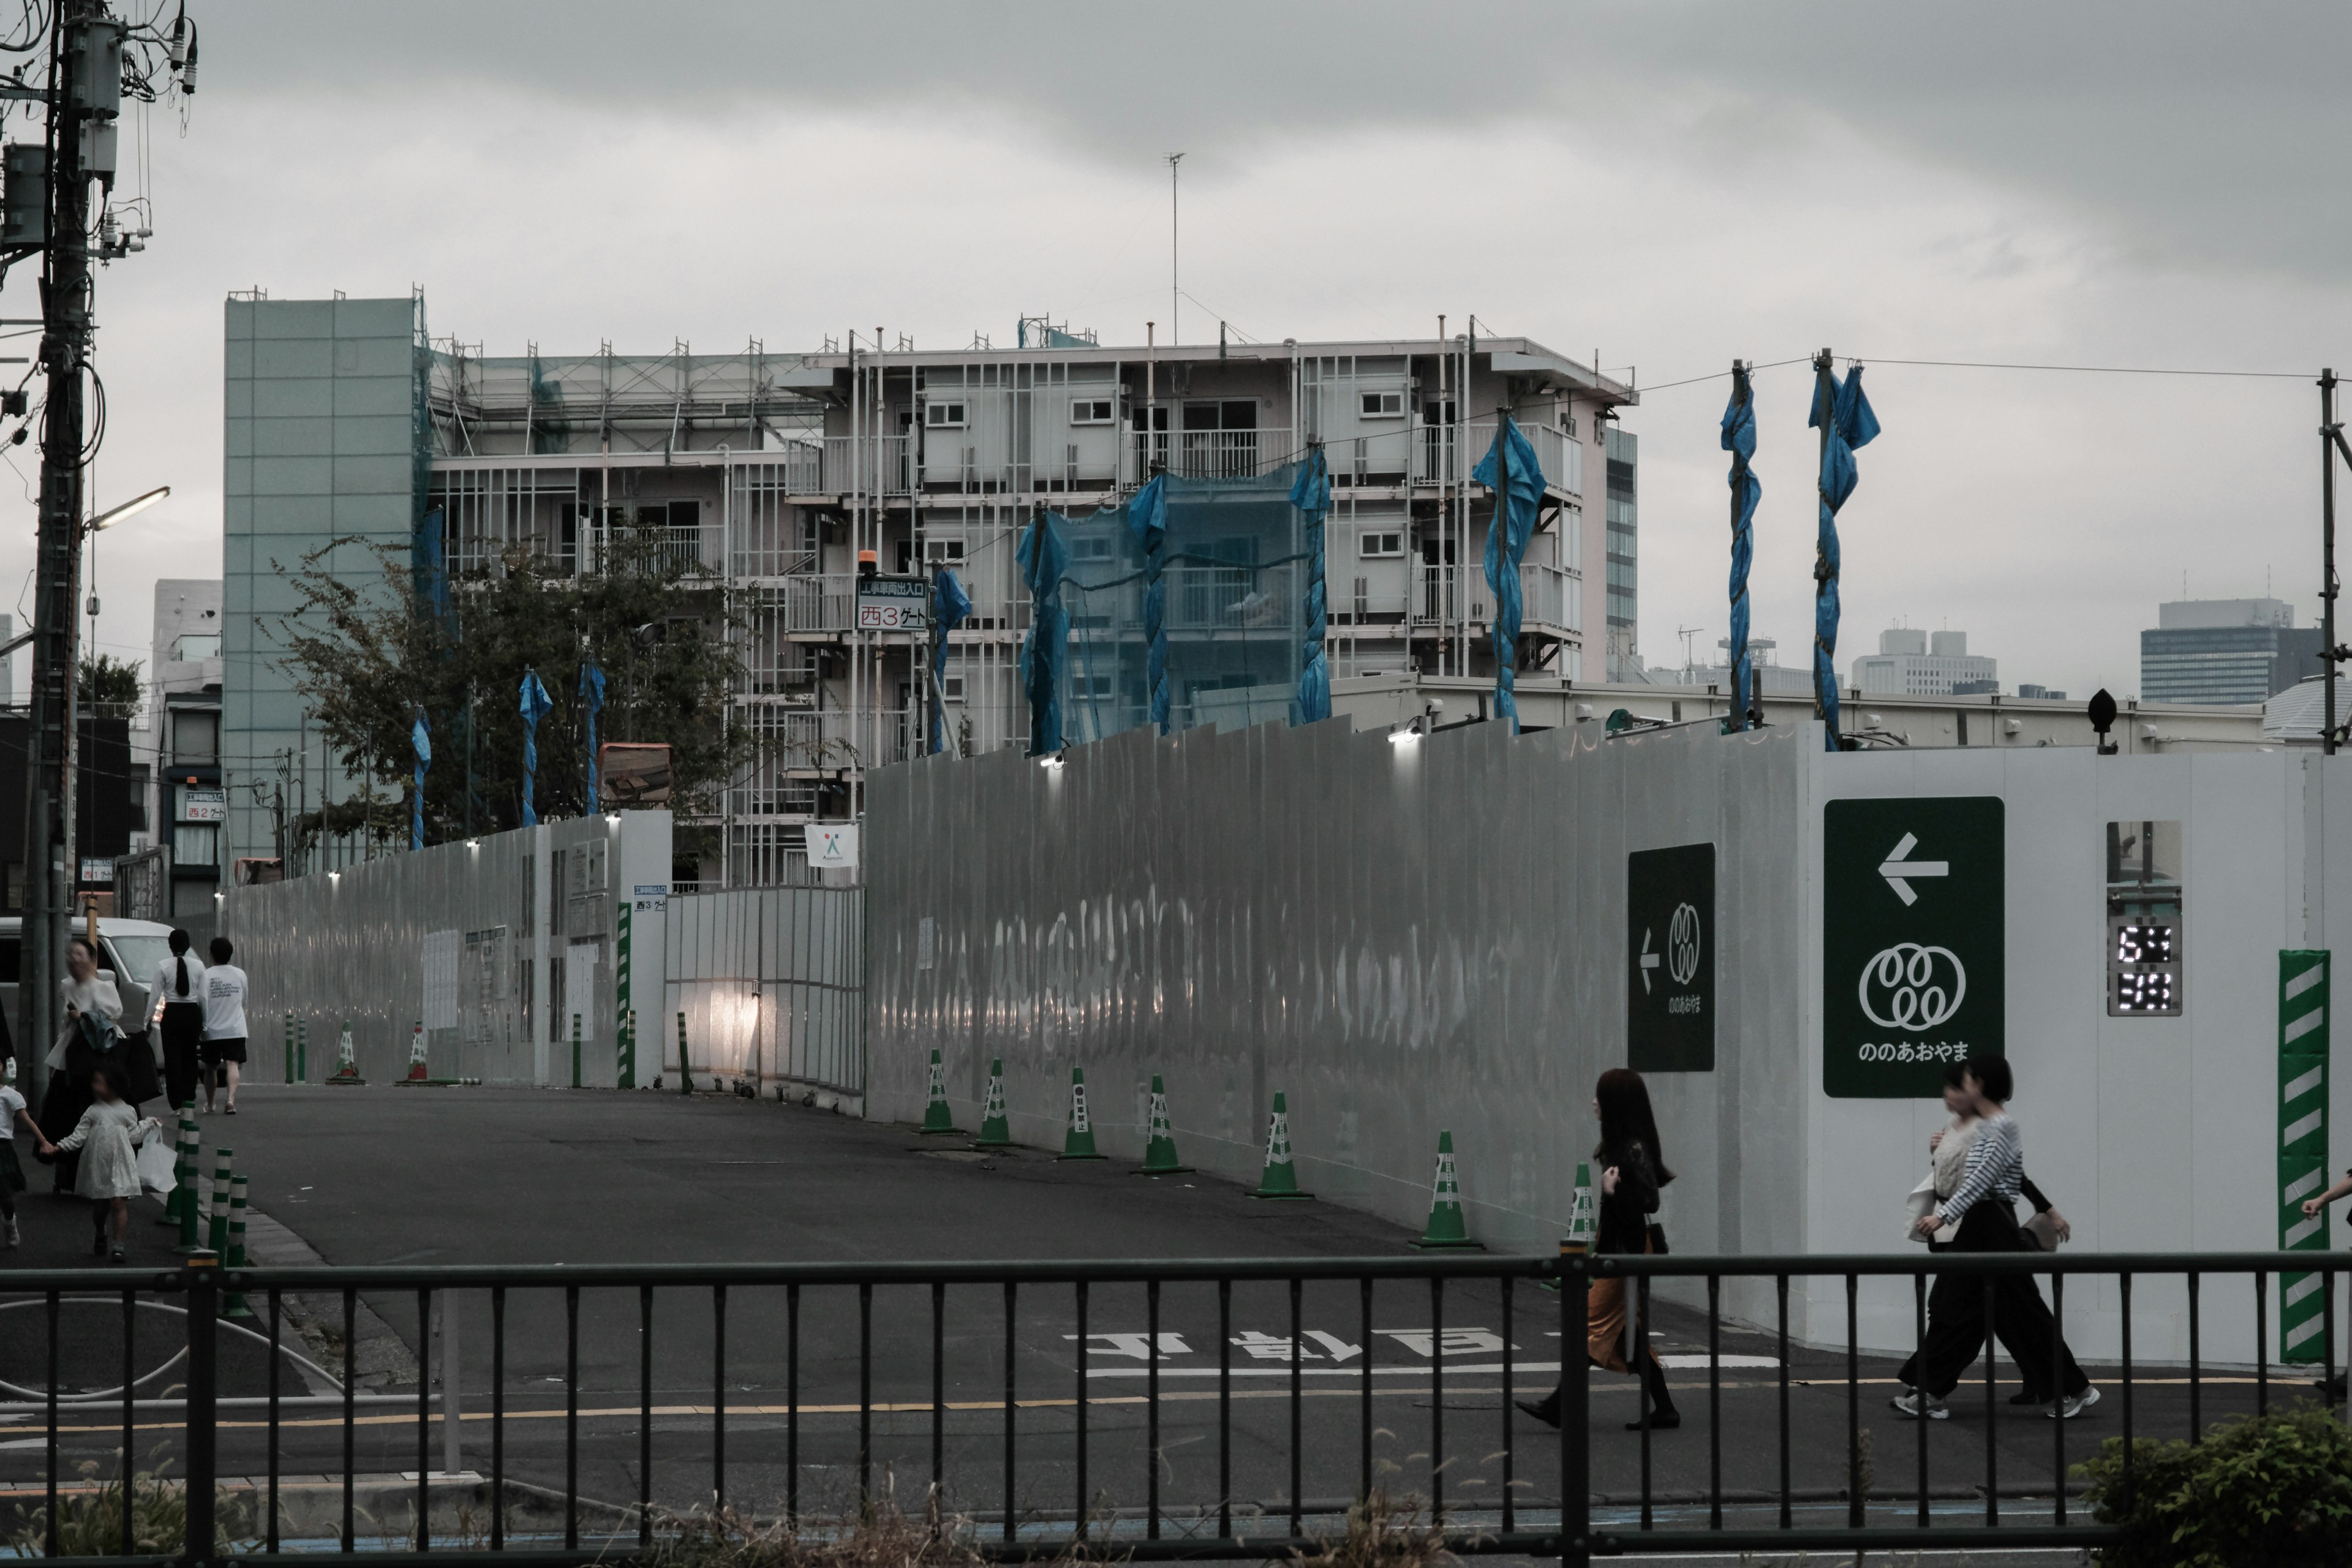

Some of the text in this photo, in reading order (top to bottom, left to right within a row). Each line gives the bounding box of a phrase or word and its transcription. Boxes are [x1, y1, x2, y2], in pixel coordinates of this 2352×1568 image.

[861, 581, 924, 596] 工事車両出入口
[1669, 994, 1701, 1014] ののあおやま
[1858, 1041, 1969, 1063] ののあおやま
[1076, 1098, 1085, 1131] 駐車禁止
[1061, 1327, 1665, 1362] 旦停止
